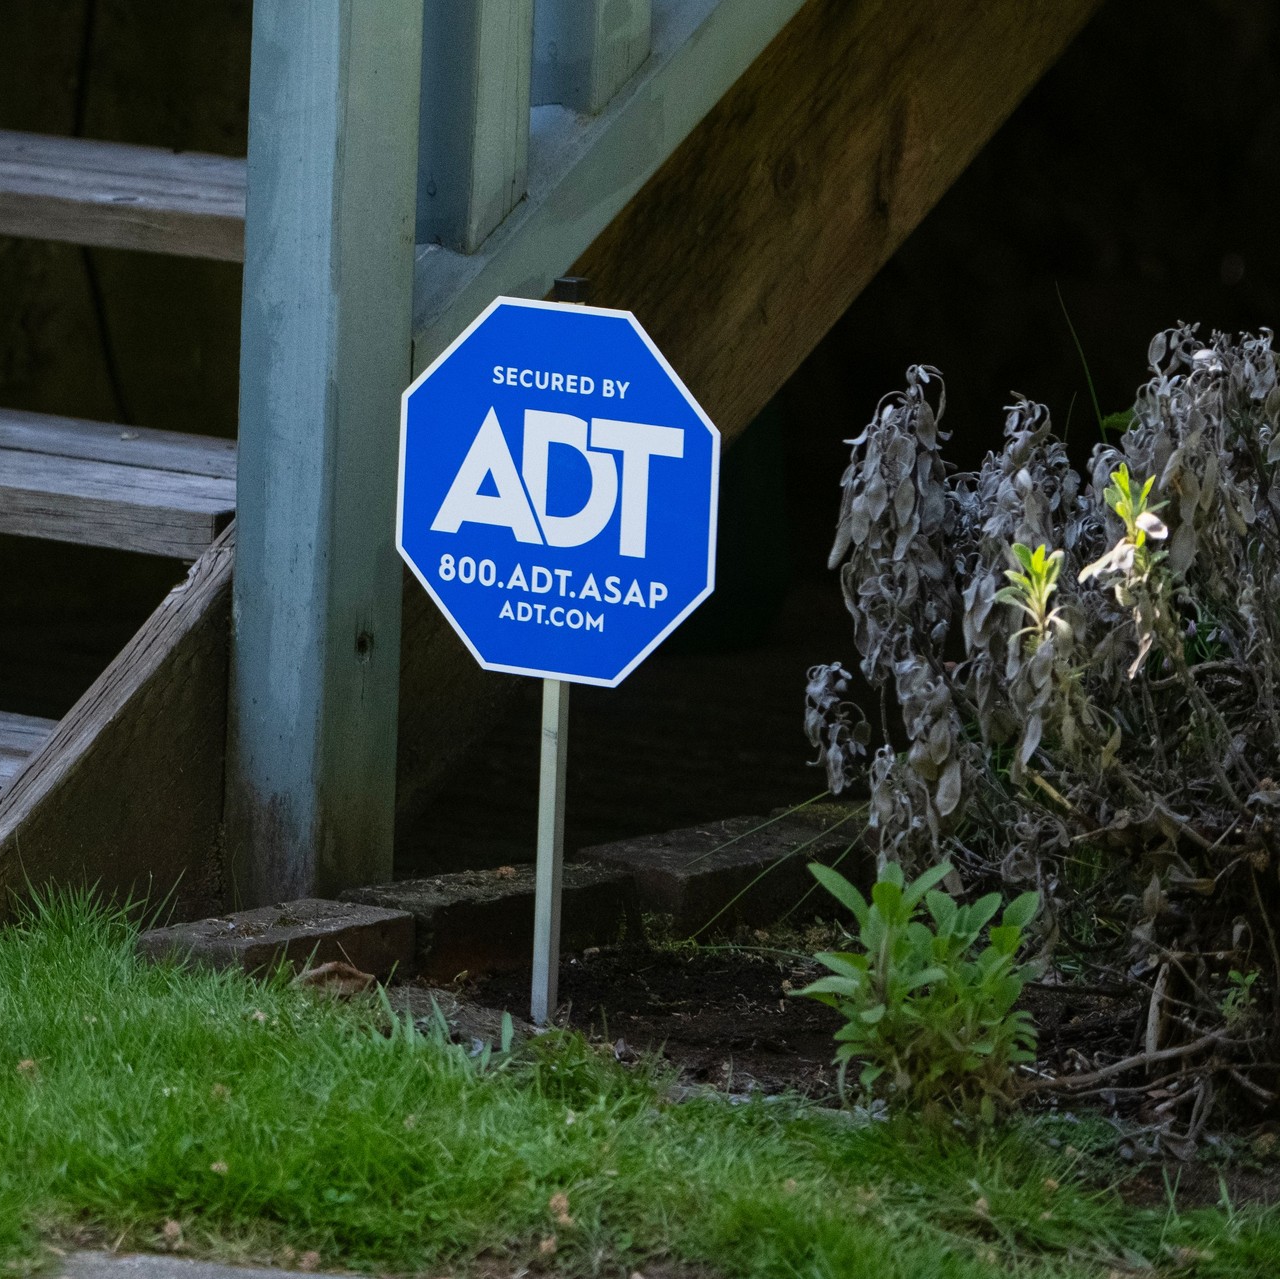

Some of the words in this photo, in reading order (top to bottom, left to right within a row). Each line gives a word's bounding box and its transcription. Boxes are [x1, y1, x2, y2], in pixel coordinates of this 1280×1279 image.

[492, 365, 595, 395] SECURED
[602, 378, 630, 399] BY
[430, 406, 685, 559] ADT
[438, 553, 669, 609] 800.ADT.ASAP
[498, 599, 604, 633] ADT.COM
